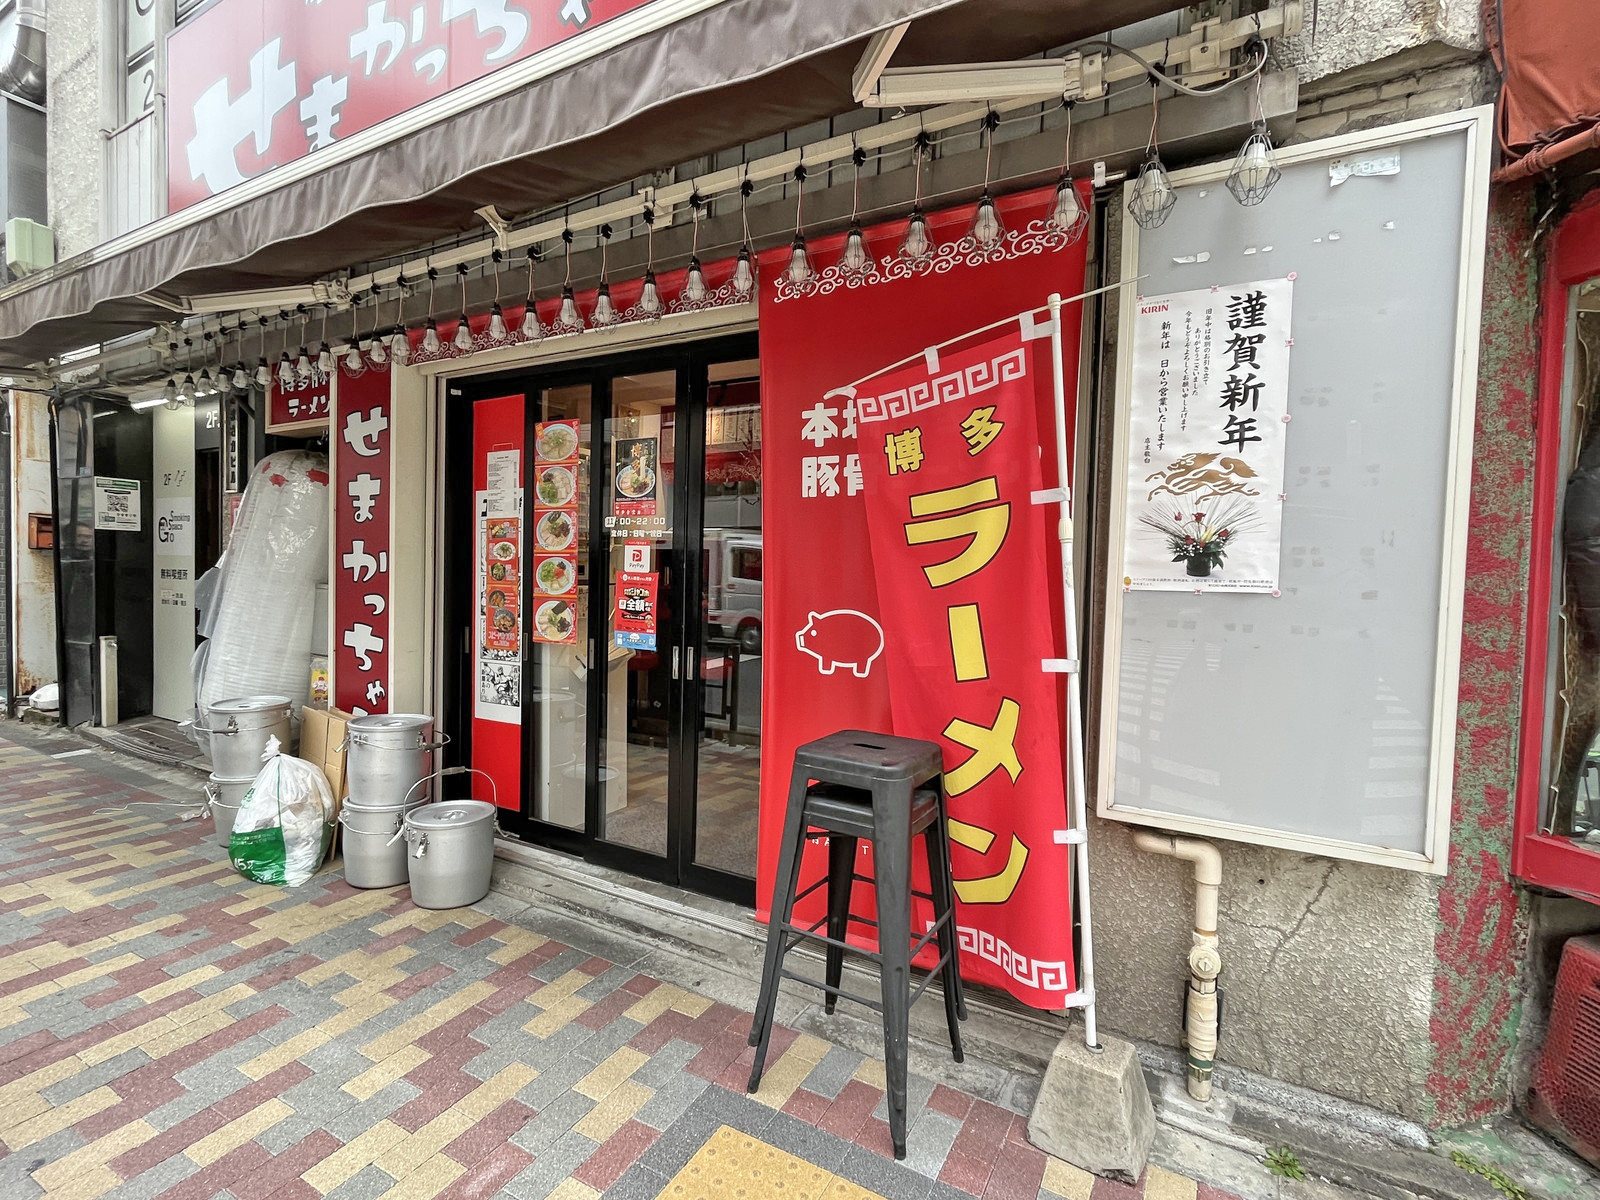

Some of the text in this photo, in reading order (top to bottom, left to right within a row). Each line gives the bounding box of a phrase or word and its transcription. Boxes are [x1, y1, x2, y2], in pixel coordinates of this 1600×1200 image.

[1141, 304, 1169, 314] KIRIN
[1217, 290, 1268, 455] 謹賀新年
[1156, 321, 1172, 452] 新年は 日から営業いたします
[168, 519, 183, 531] Space
[170, 510, 191, 522] Smoking
[342, 405, 389, 716] せまかっちゃ
[903, 475, 1030, 905] ラーメン
